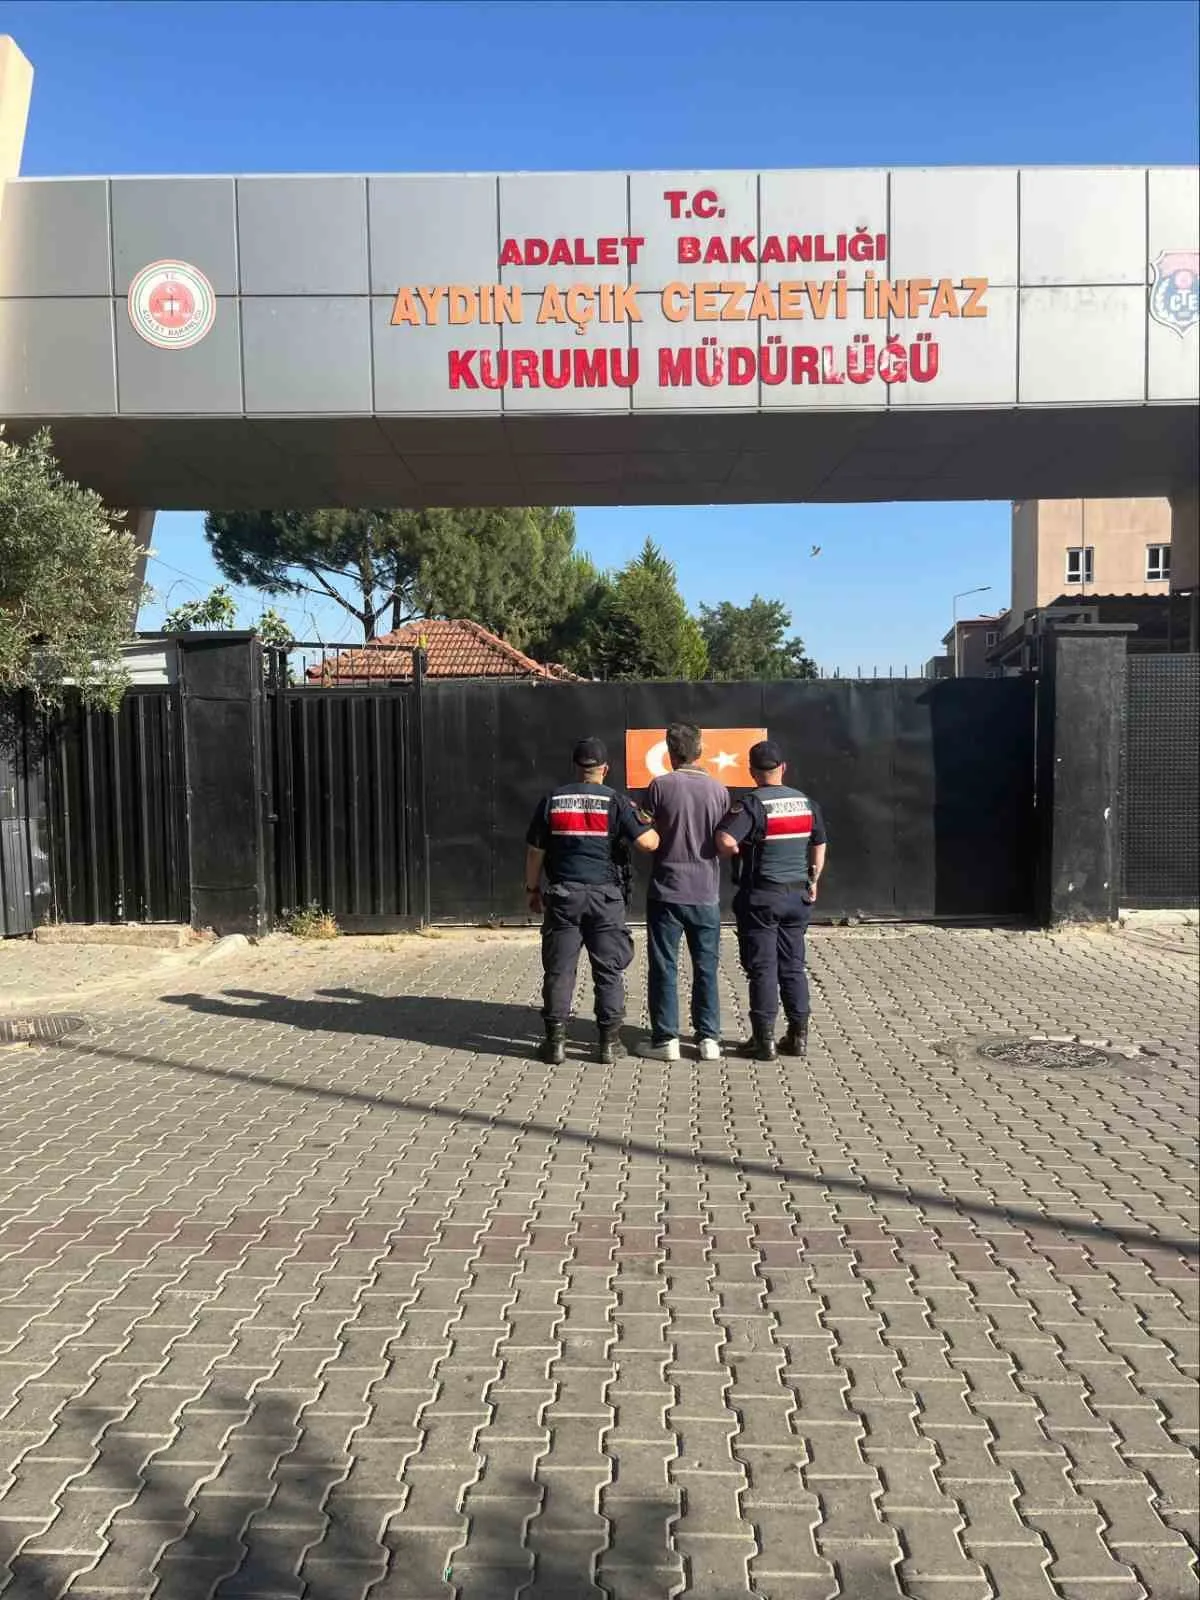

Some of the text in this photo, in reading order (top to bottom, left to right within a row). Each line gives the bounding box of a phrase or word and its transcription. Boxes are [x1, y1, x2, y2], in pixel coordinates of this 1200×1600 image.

[664, 190, 726, 219] T.C.
[500, 226, 887, 265] ADALET BAKANLIĞI
[391, 284, 522, 325] AYDIN
[536, 283, 643, 335] AÇIK
[661, 270, 848, 322] CEZAEVİ
[864, 270, 989, 319] İNFAZ
[448, 333, 939, 389] KURUMU MÜDÜRLÜĞÜ
